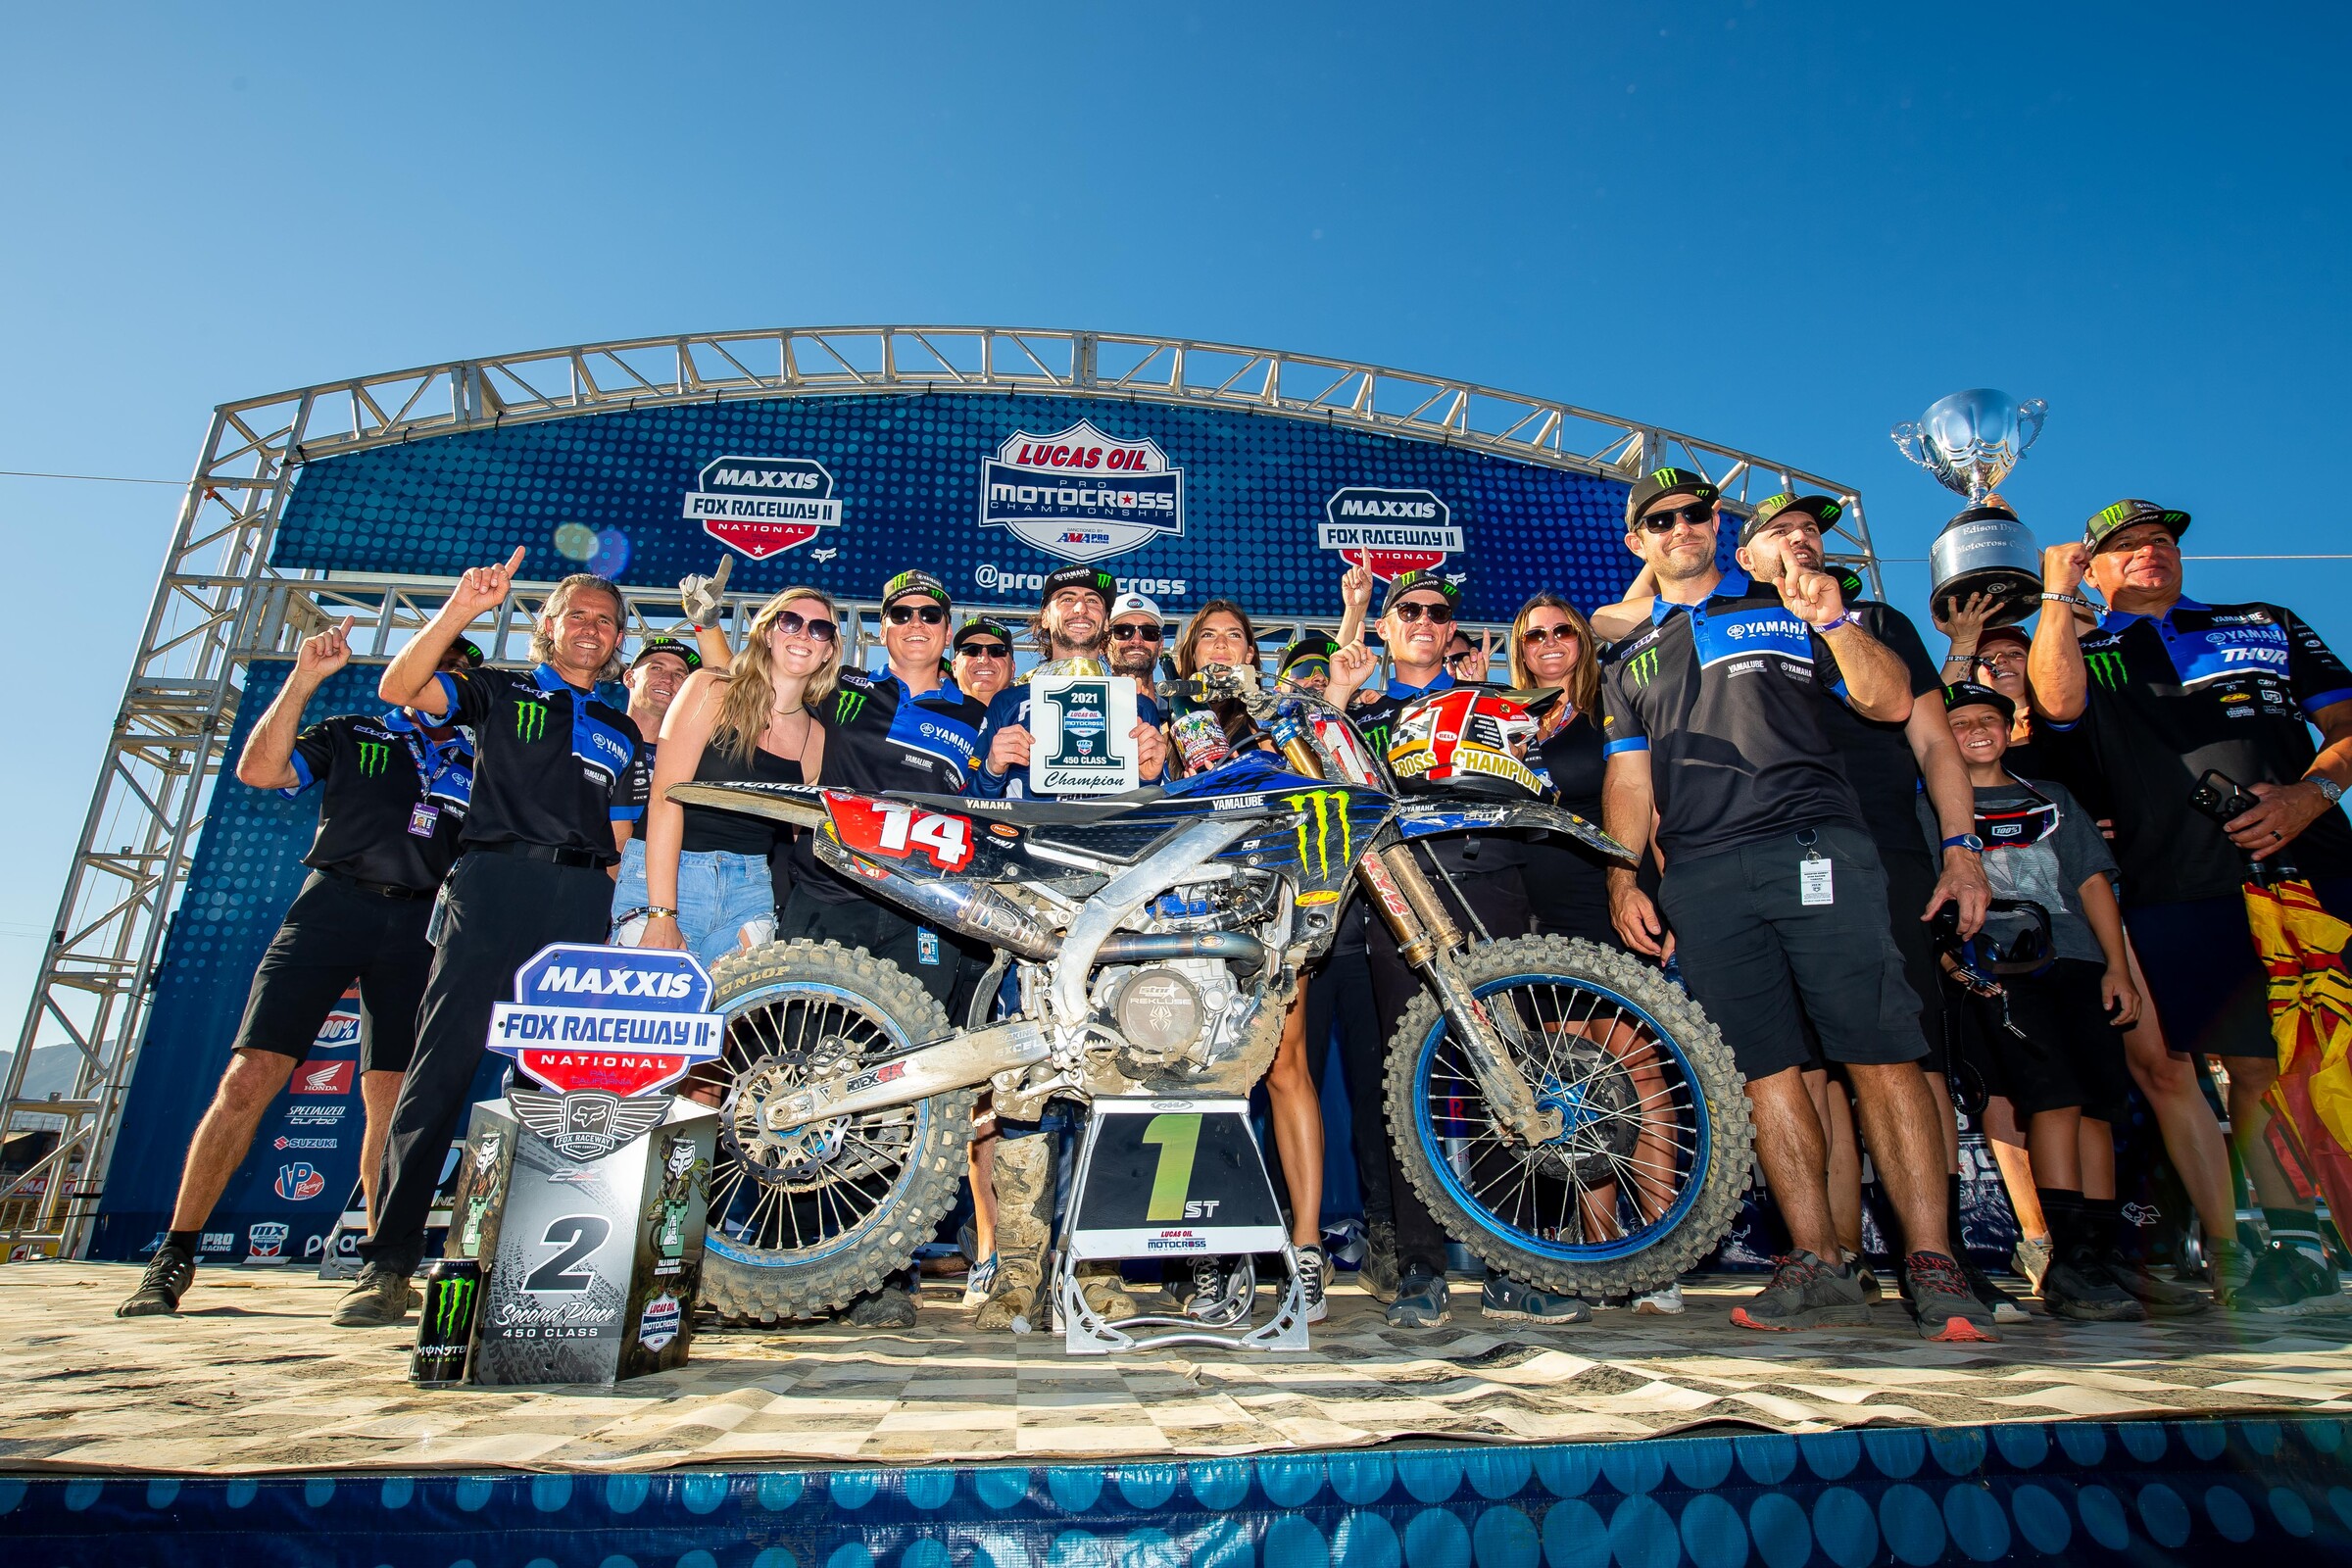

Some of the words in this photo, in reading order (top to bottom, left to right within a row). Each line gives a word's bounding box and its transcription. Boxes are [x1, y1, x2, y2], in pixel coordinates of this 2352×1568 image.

[1016, 444, 1102, 468] LUCAS
[1106, 448, 1148, 471] OIL
[712, 468, 819, 489] MAXXIS
[1059, 479, 1107, 489] PRO
[991, 483, 1174, 511] MOTOCROSS
[693, 498, 729, 514] FOX
[731, 500, 819, 519] RACEWAY
[822, 505, 832, 520] II
[990, 501, 1174, 517] CHAMPIONSHIP
[1341, 500, 1436, 517] MAXXIS
[717, 523, 805, 534] NATIONAL
[1963, 523, 1997, 535] Edison
[1055, 532, 1090, 543] AMA
[1327, 528, 1359, 544] FOX
[1361, 529, 1442, 547] RACEWAY
[1445, 532, 1455, 547] II
[1958, 541, 2006, 553] Motocross
[975, 564, 1186, 595] @procross
[1061, 568, 1091, 577] YAMAHA
[1744, 620, 1809, 635] YAMAHA
[2221, 648, 2287, 665] THOR
[1727, 660, 1764, 673] YAMALUBE
[1788, 663, 1812, 678] YAMAHA
[1071, 693, 1098, 704] 2021
[1044, 681, 1124, 770] 1
[936, 727, 974, 757] YAMAHA
[906, 754, 933, 768] YAMALUBE
[1451, 751, 1543, 795] CHAMPION
[1044, 771, 1125, 792] Champion
[964, 799, 1012, 810] YAMAHA
[1212, 795, 1264, 810] YAMALUBE
[871, 803, 967, 864] 14
[1995, 825, 2019, 835] 100%
[1300, 892, 1339, 905] FMF
[537, 966, 694, 999] MAXXIS
[318, 1020, 355, 1039] 00%
[504, 1013, 559, 1041] FOX
[562, 1016, 691, 1046] RACEWAY
[694, 1022, 710, 1047] II
[540, 1054, 668, 1069] NATIONAL
[570, 1077, 632, 1086] CALIFORNIA
[289, 1105, 346, 1115] SPECIALIZED
[289, 1139, 337, 1149] SUZUKI
[559, 1135, 574, 1144] FOX
[575, 1135, 611, 1145] RACEWAY
[279, 1162, 314, 1199] VP
[298, 1179, 324, 1192] Racing
[202, 1233, 234, 1246] PRO
[519, 1213, 613, 1294] 2
[495, 1301, 567, 1326] Second
[562, 1301, 618, 1324] Place
[650, 1303, 665, 1313] LUCAS
[666, 1302, 675, 1312] OIL
[643, 1319, 678, 1331] MOTOCROSS
[503, 1328, 537, 1339] 450
[544, 1327, 599, 1338] CLASS
